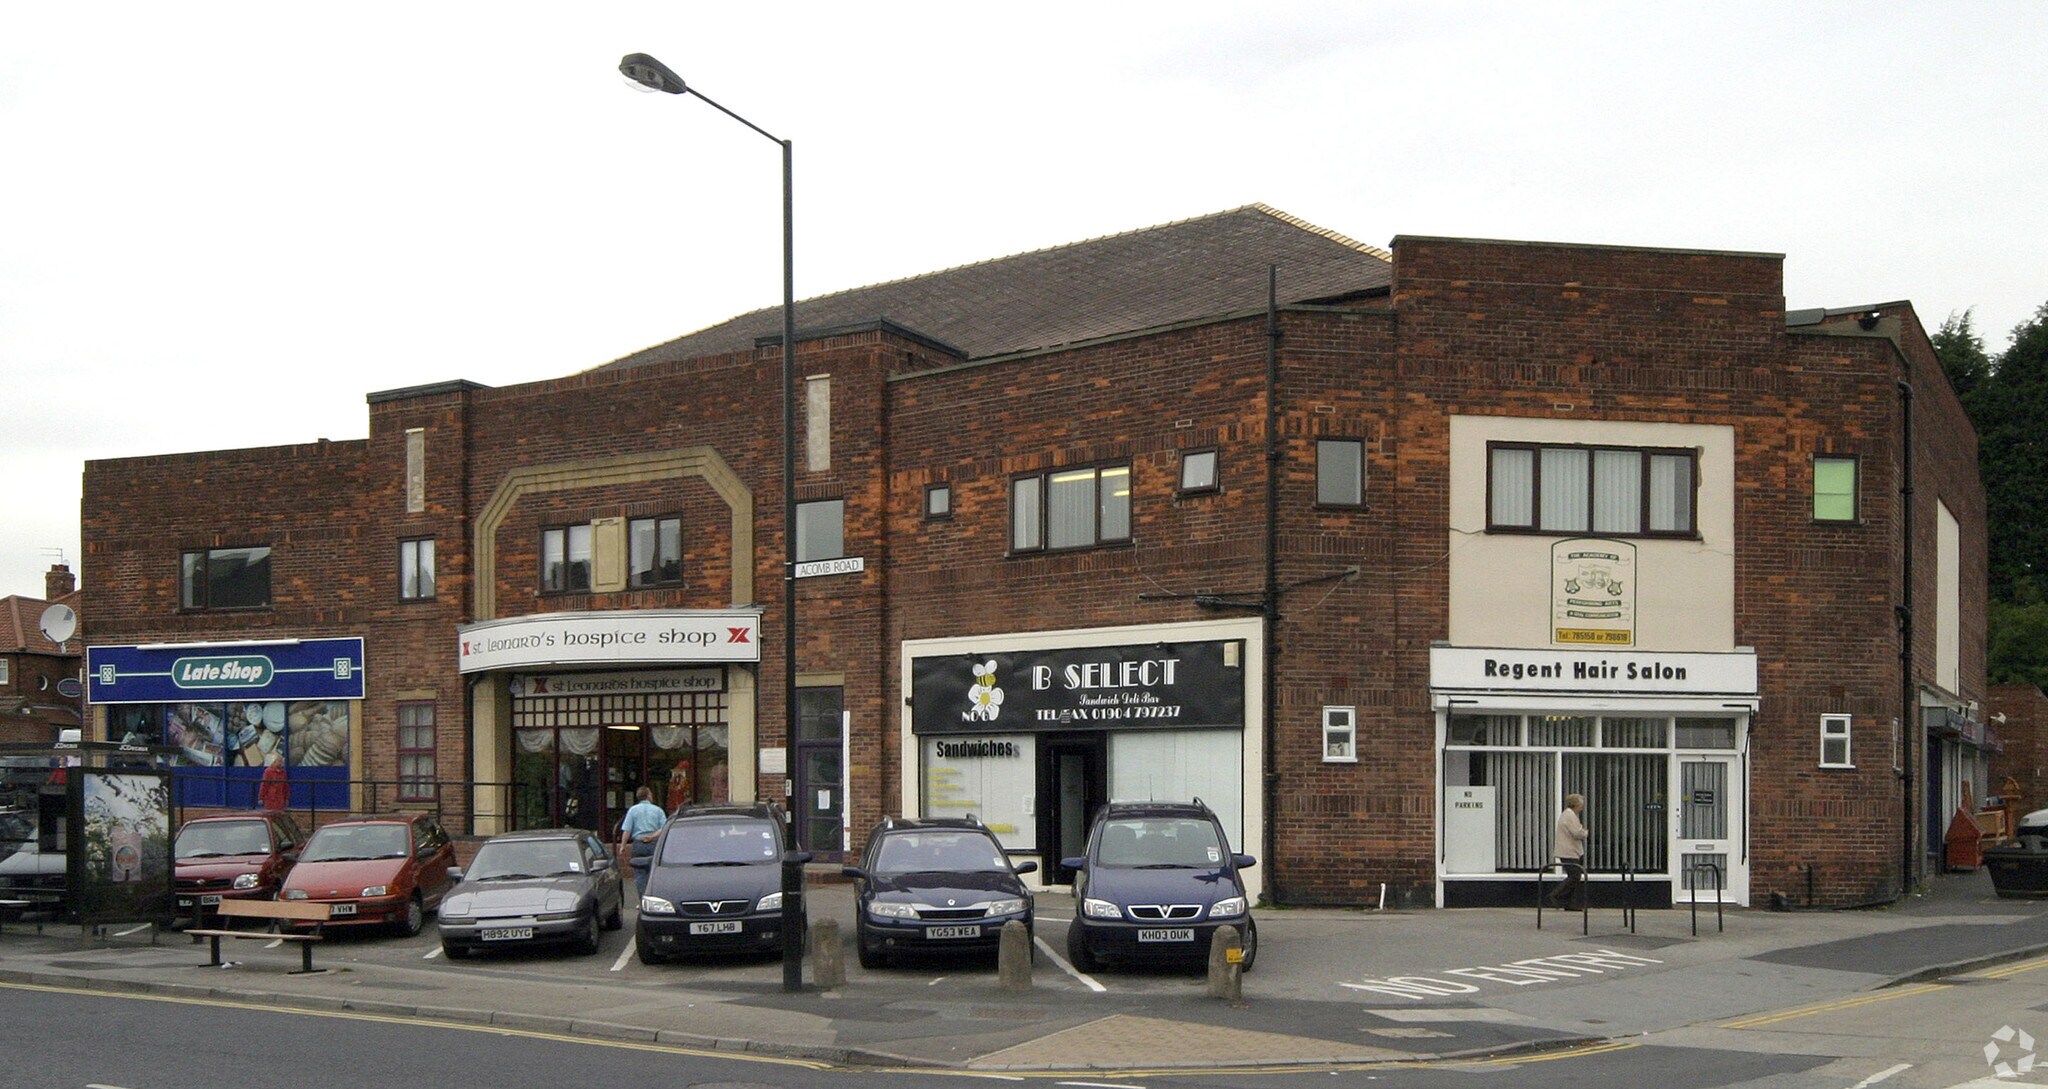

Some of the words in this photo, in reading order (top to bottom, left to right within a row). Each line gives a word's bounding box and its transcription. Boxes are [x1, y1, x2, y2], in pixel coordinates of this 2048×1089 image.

[800, 563, 831, 576] ACOMB
[833, 560, 859, 572] ROAD
[564, 629, 646, 648] hospice
[659, 628, 717, 648] shop
[1032, 665, 1052, 691] B
[1063, 658, 1181, 690] SELECT
[1484, 658, 1562, 680] Regent
[1573, 660, 1619, 680] Hair
[1627, 661, 1687, 681] Salon
[630, 677, 681, 692] hospice
[683, 676, 716, 690] shop
[1079, 693, 1120, 706] Sandwich
[1121, 692, 1140, 704] Deli
[1141, 691, 1160, 704] Bar
[1091, 706, 1131, 720] 01904
[1134, 705, 1181, 719] 797237
[936, 740, 1013, 758] Sandwiches
[1463, 790, 1473, 798] NO
[1454, 801, 1484, 809] PARKING
[202, 896, 221, 905] BRA
[336, 905, 354, 914] VHW
[482, 929, 508, 941] H892
[510, 928, 533, 940] UYG
[697, 923, 716, 934] Y67
[717, 922, 736, 933] LHB
[929, 927, 955, 938] YG53
[957, 926, 977, 937] WEA
[1141, 930, 1168, 942] KH03
[1169, 930, 1191, 941] OUK
[1339, 974, 1481, 1000] NO
[1444, 948, 1664, 987] ENTRY
